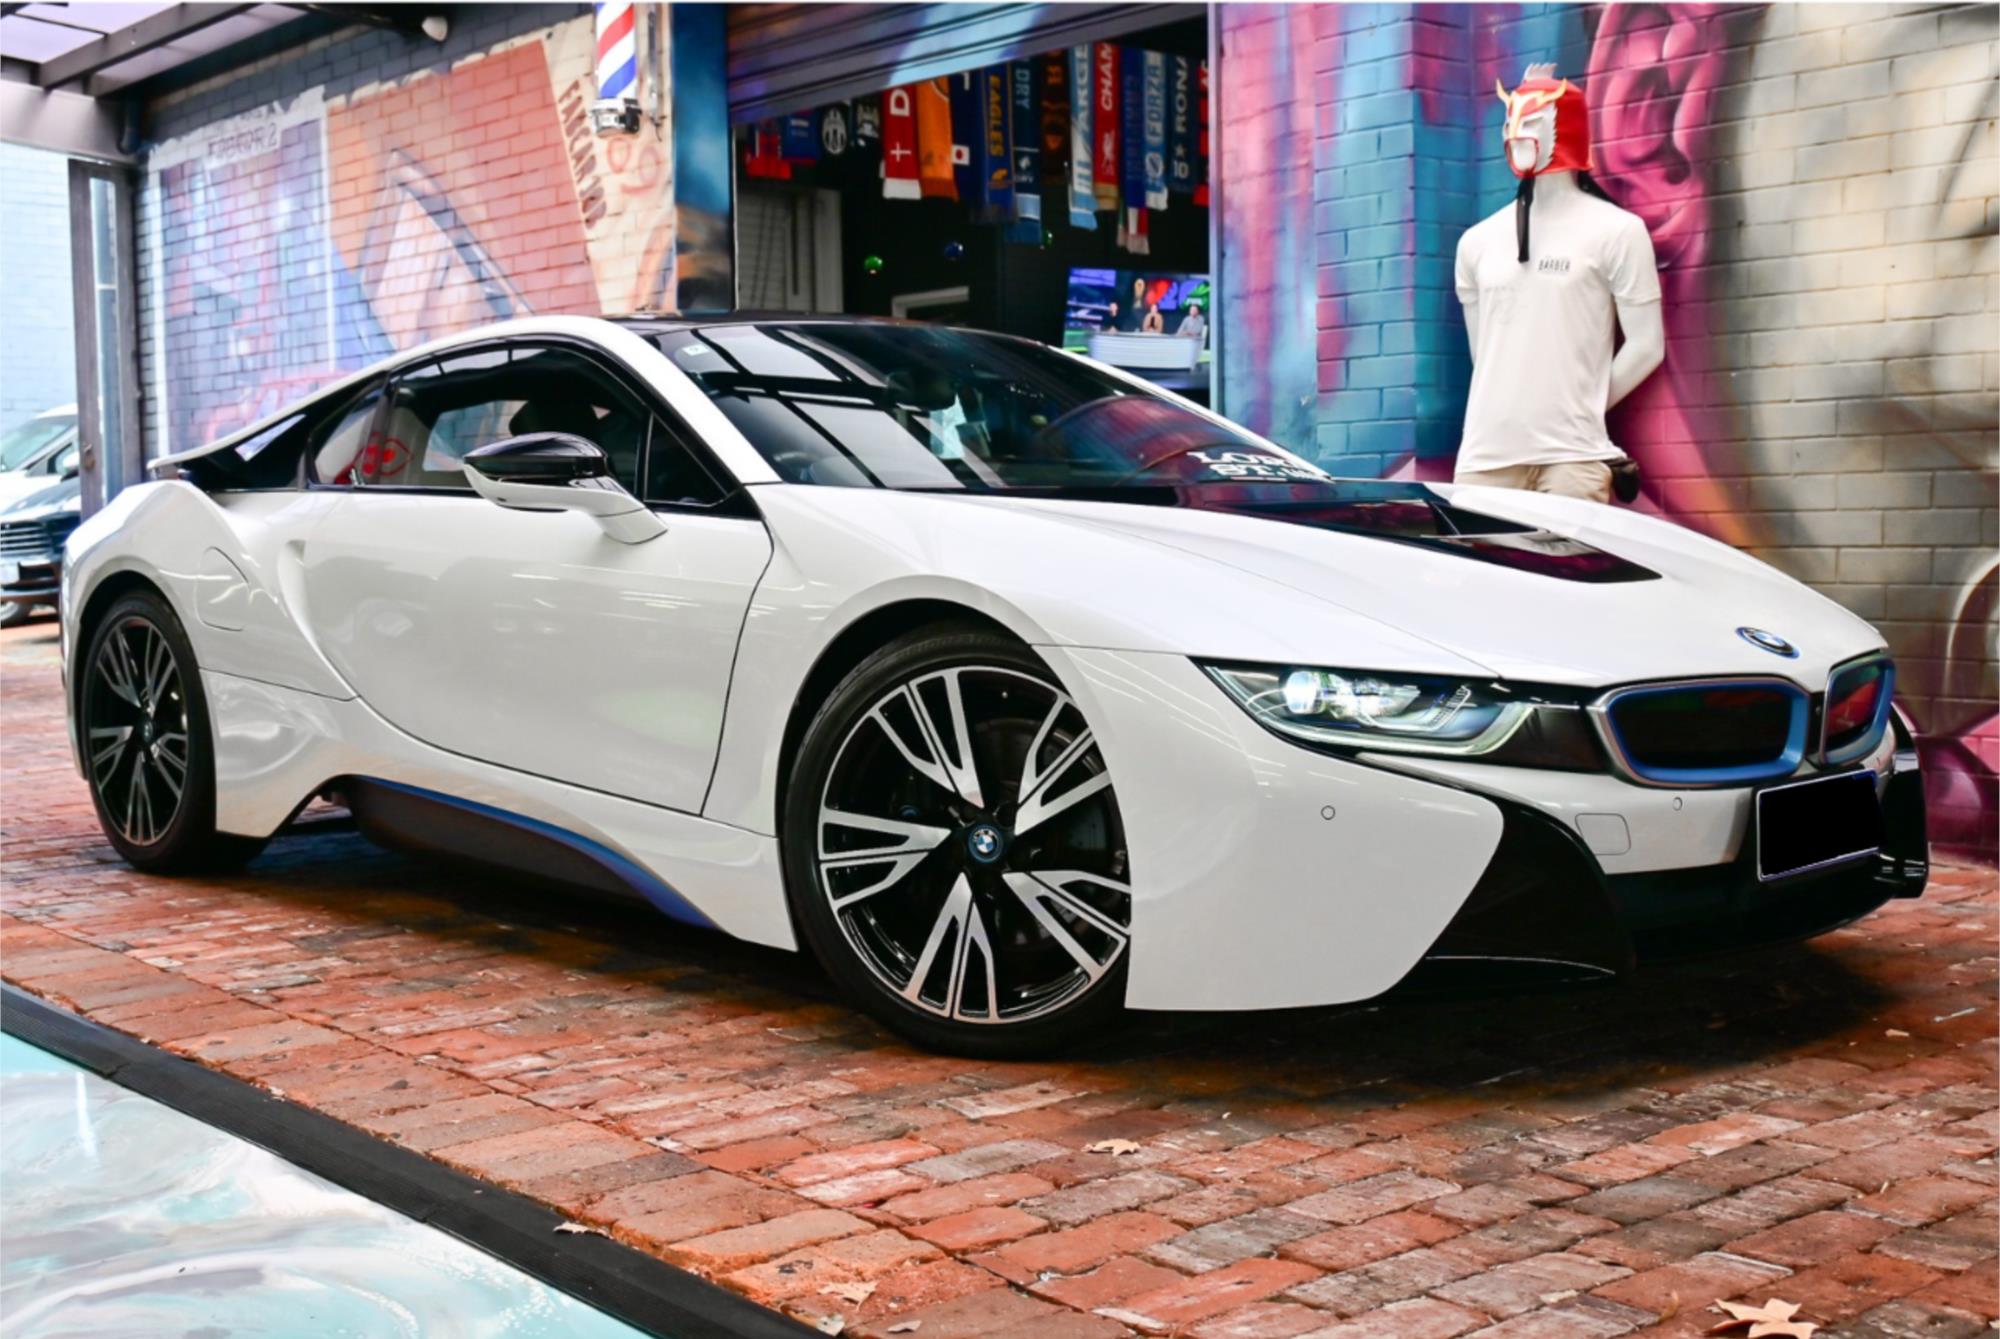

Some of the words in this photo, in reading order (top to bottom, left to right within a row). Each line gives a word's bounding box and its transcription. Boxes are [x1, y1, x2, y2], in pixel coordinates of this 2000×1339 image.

[990, 74, 1004, 157] EAGLES
[1173, 158, 1189, 179] 10
[1538, 258, 1571, 273] BARBER
